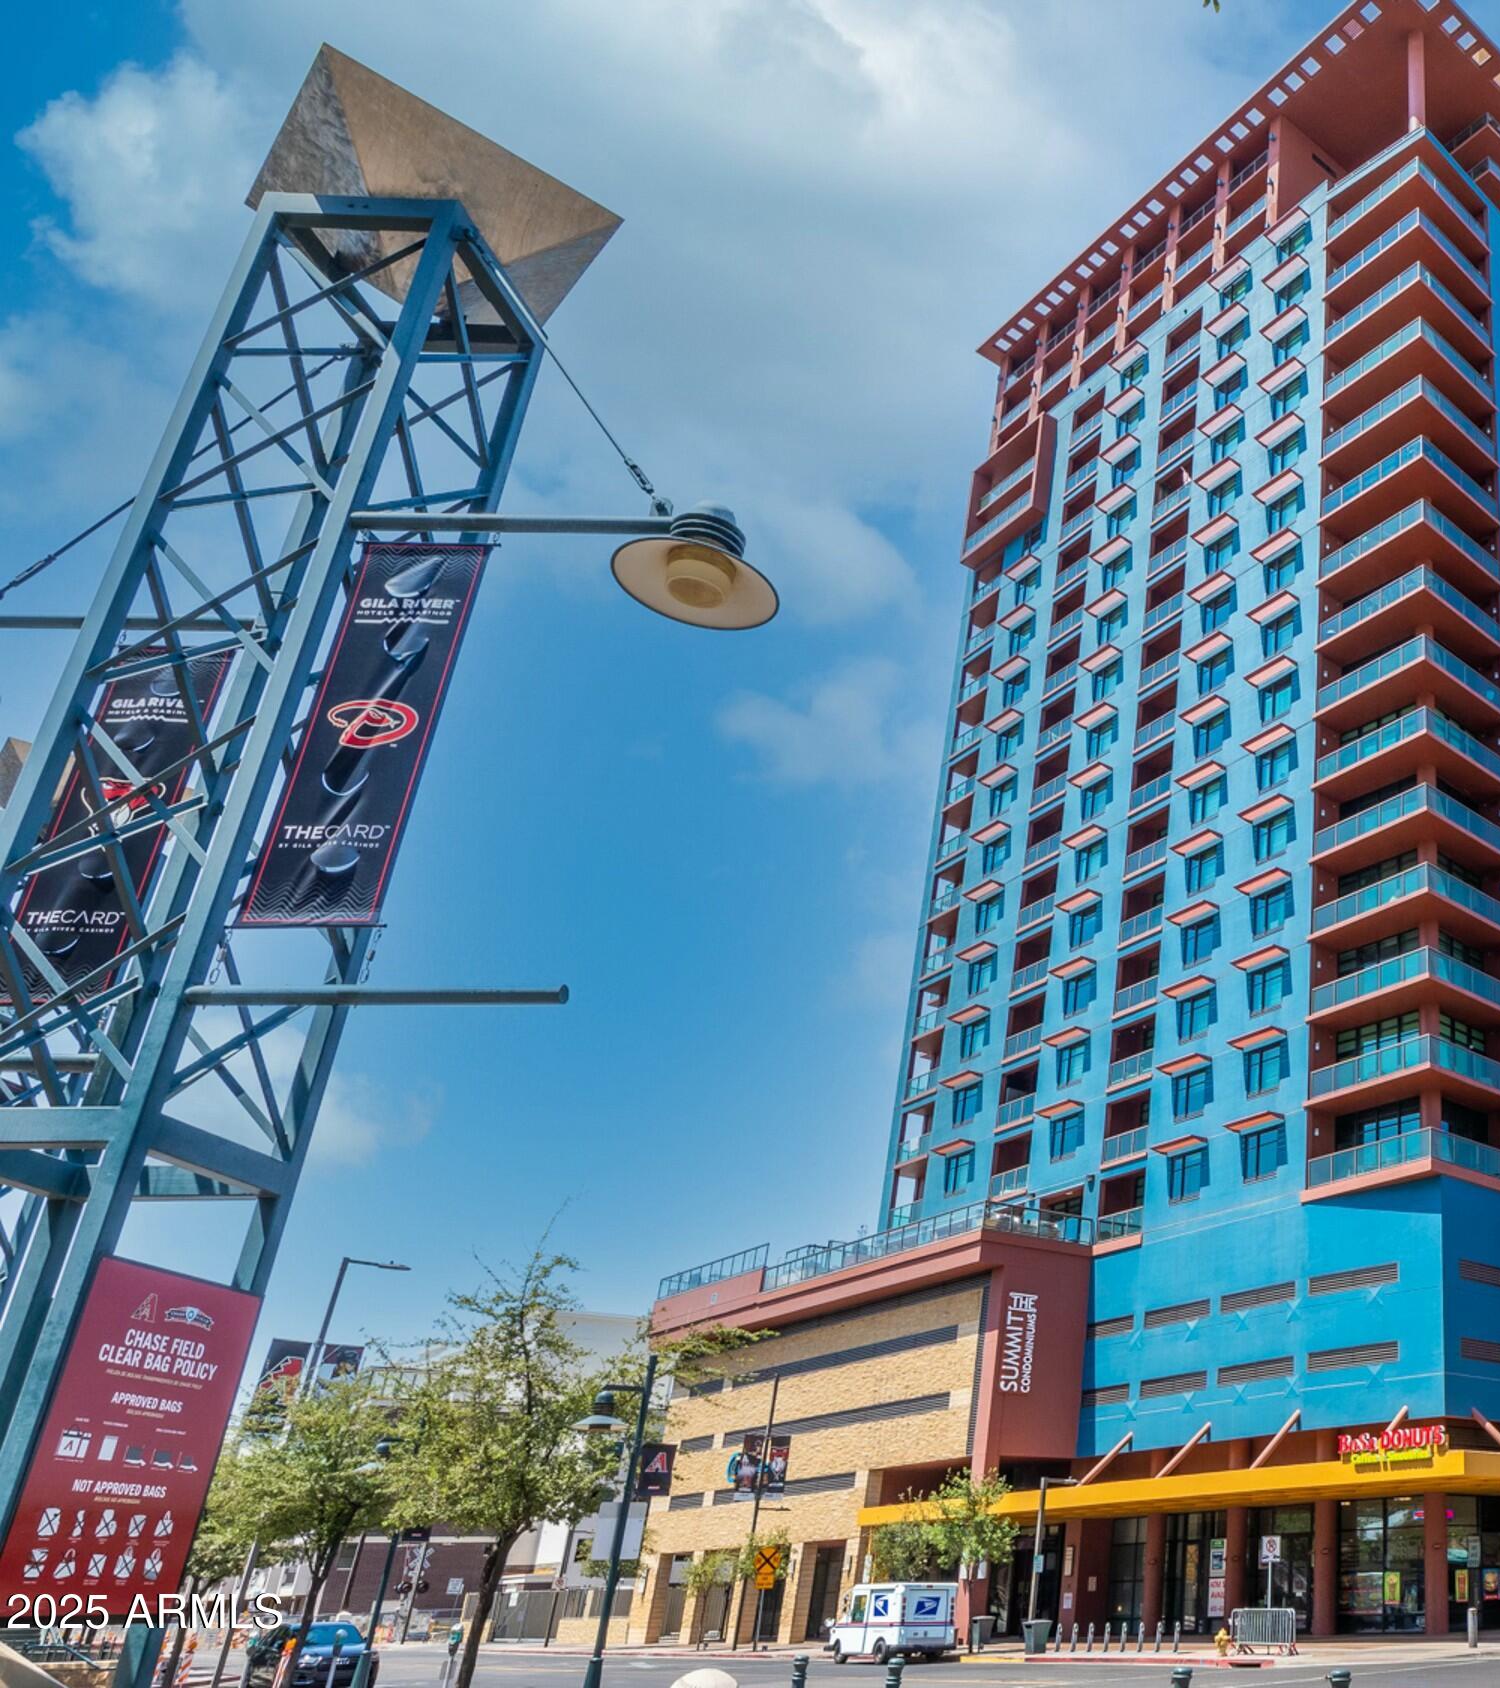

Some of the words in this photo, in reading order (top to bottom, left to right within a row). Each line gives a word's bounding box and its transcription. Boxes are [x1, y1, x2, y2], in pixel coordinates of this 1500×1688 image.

[360, 598, 399, 609] GILA
[403, 599, 455, 609] RIVER
[111, 698, 145, 709] GILA
[147, 697, 184, 709] RIVE
[1013, 1296, 1035, 1310] THE
[124, 1328, 170, 1353] CHASE
[170, 1338, 205, 1360] FIELD
[1000, 1310, 1024, 1392] SUMMIT
[1021, 1313, 1037, 1393] CONDOMINIUMS
[98, 1343, 142, 1368] CLEAR
[144, 1352, 171, 1373] BAG
[173, 1358, 218, 1381] POLICY
[111, 1391, 158, 1410] APPROVED
[158, 1399, 183, 1413] BAGS
[1381, 1425, 1446, 1449] DONUTS
[72, 1479, 94, 1493] NOT
[94, 1483, 142, 1497] APPROVED
[142, 1485, 167, 1499] BAGS
